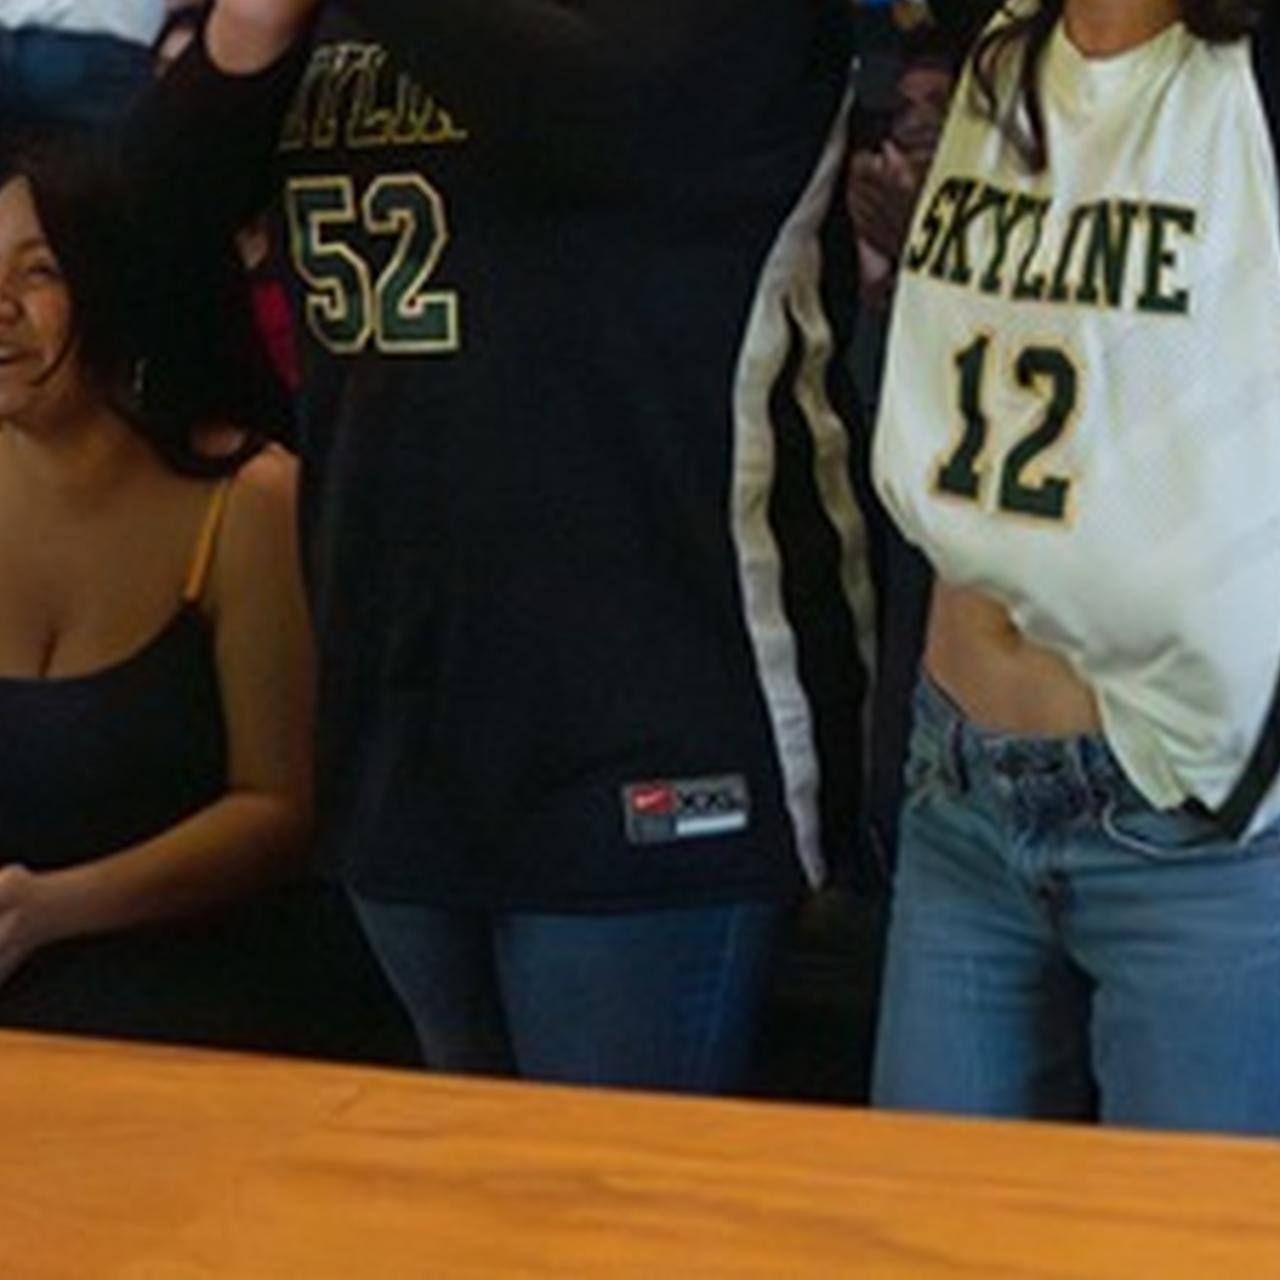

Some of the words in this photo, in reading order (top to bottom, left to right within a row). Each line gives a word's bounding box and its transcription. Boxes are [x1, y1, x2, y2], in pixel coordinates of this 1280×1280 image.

[286, 172, 459, 353] 52
[906, 176, 1198, 315] SKYLINE
[930, 327, 1081, 527] 12
[676, 788, 745, 815] XXL
